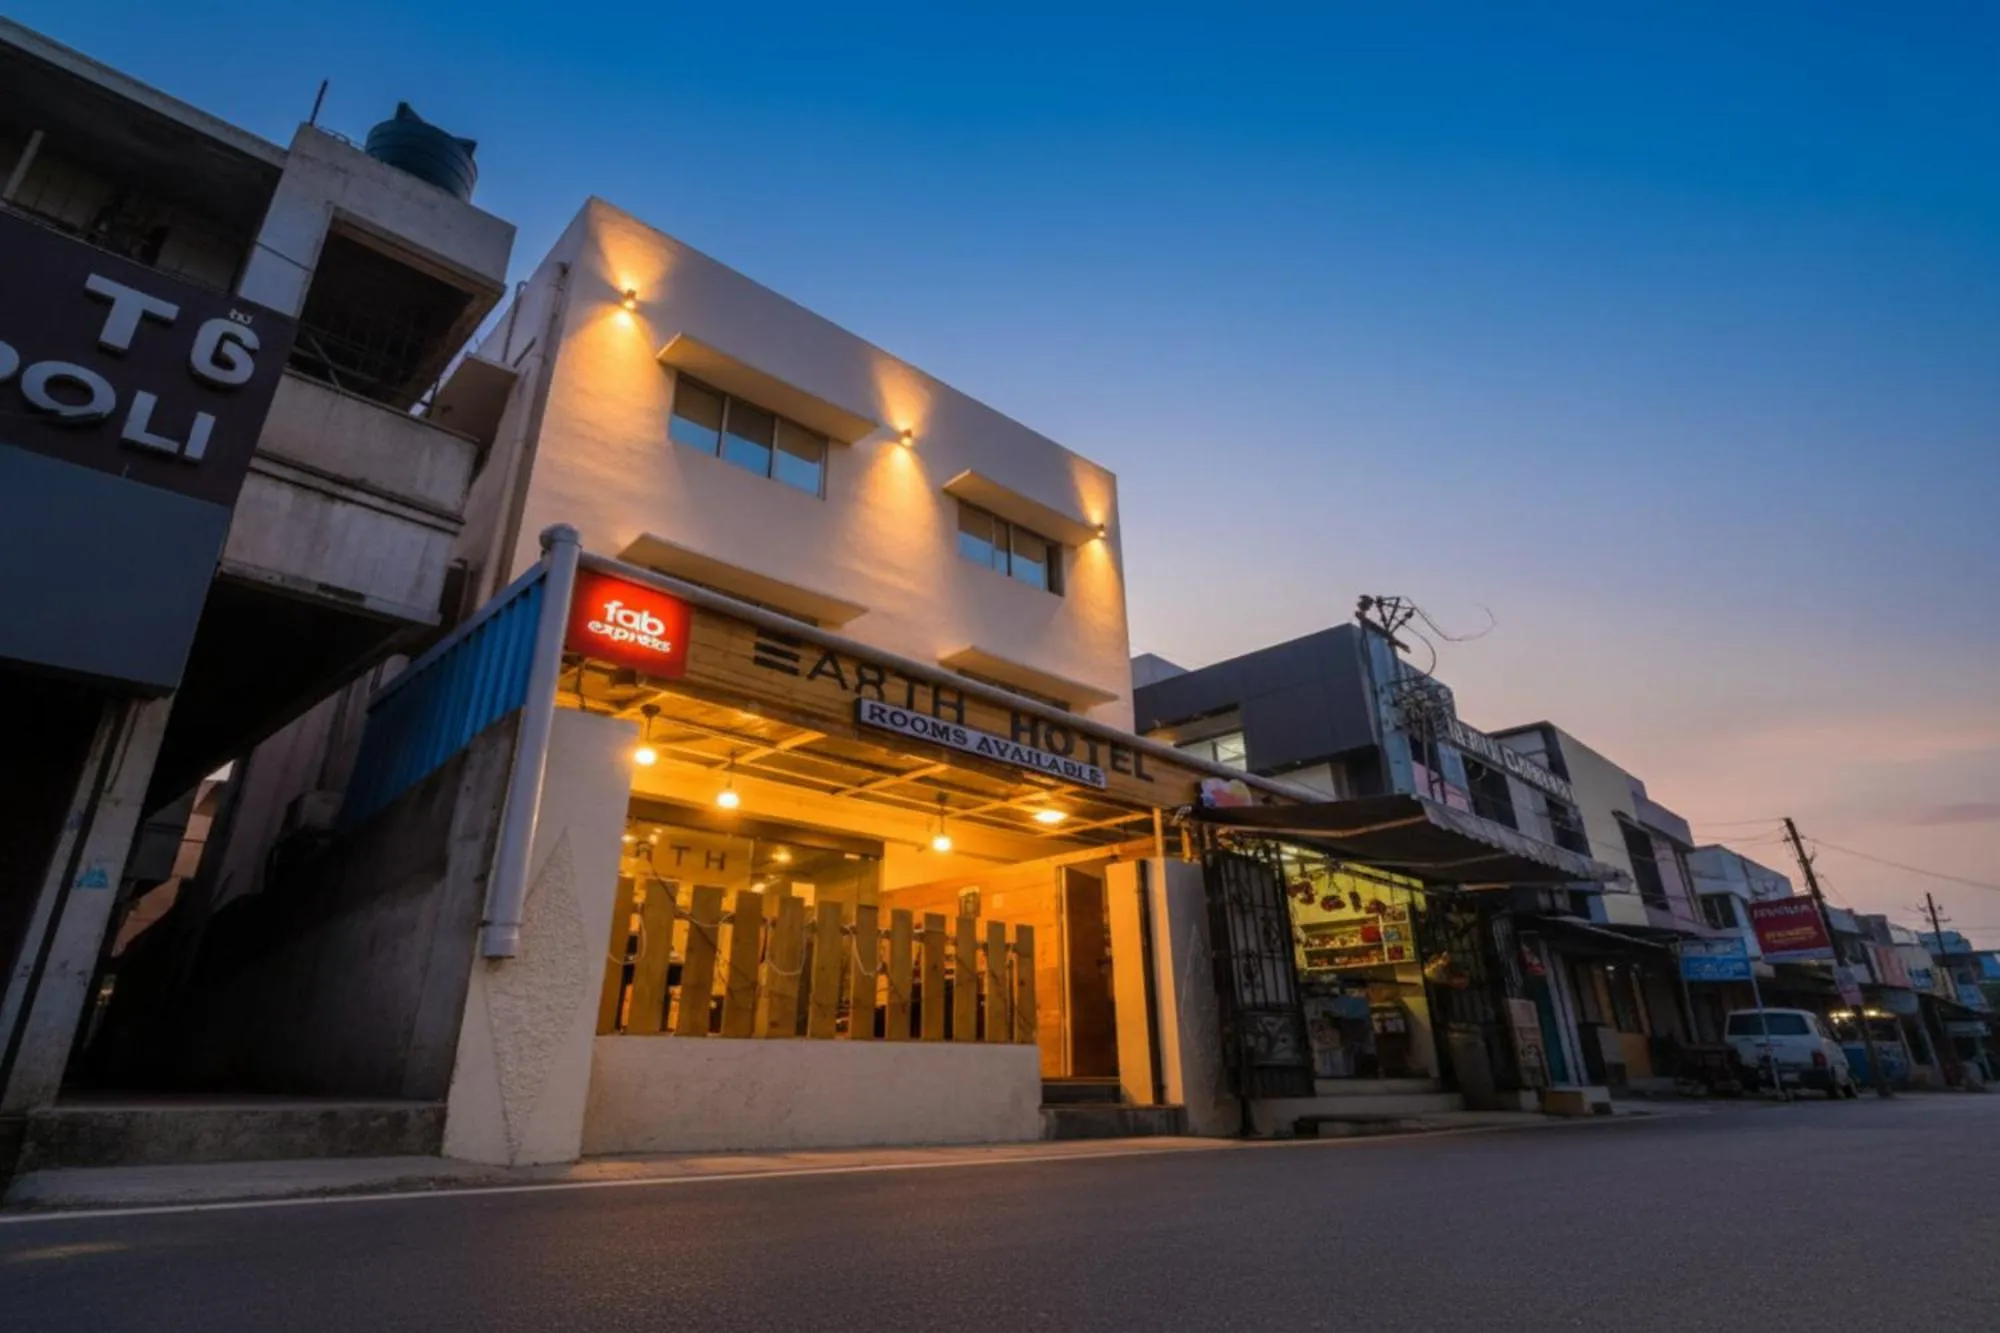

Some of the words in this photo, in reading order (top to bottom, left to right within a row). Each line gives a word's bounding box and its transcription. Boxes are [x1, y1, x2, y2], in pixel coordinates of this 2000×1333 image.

[587, 620, 671, 653] express
[603, 600, 665, 636] fab
[754, 627, 964, 725] EARTH
[1010, 709, 1154, 782] HOTEL
[867, 703, 968, 745] ROOMS
[976, 735, 1106, 788] AVAILABLE
